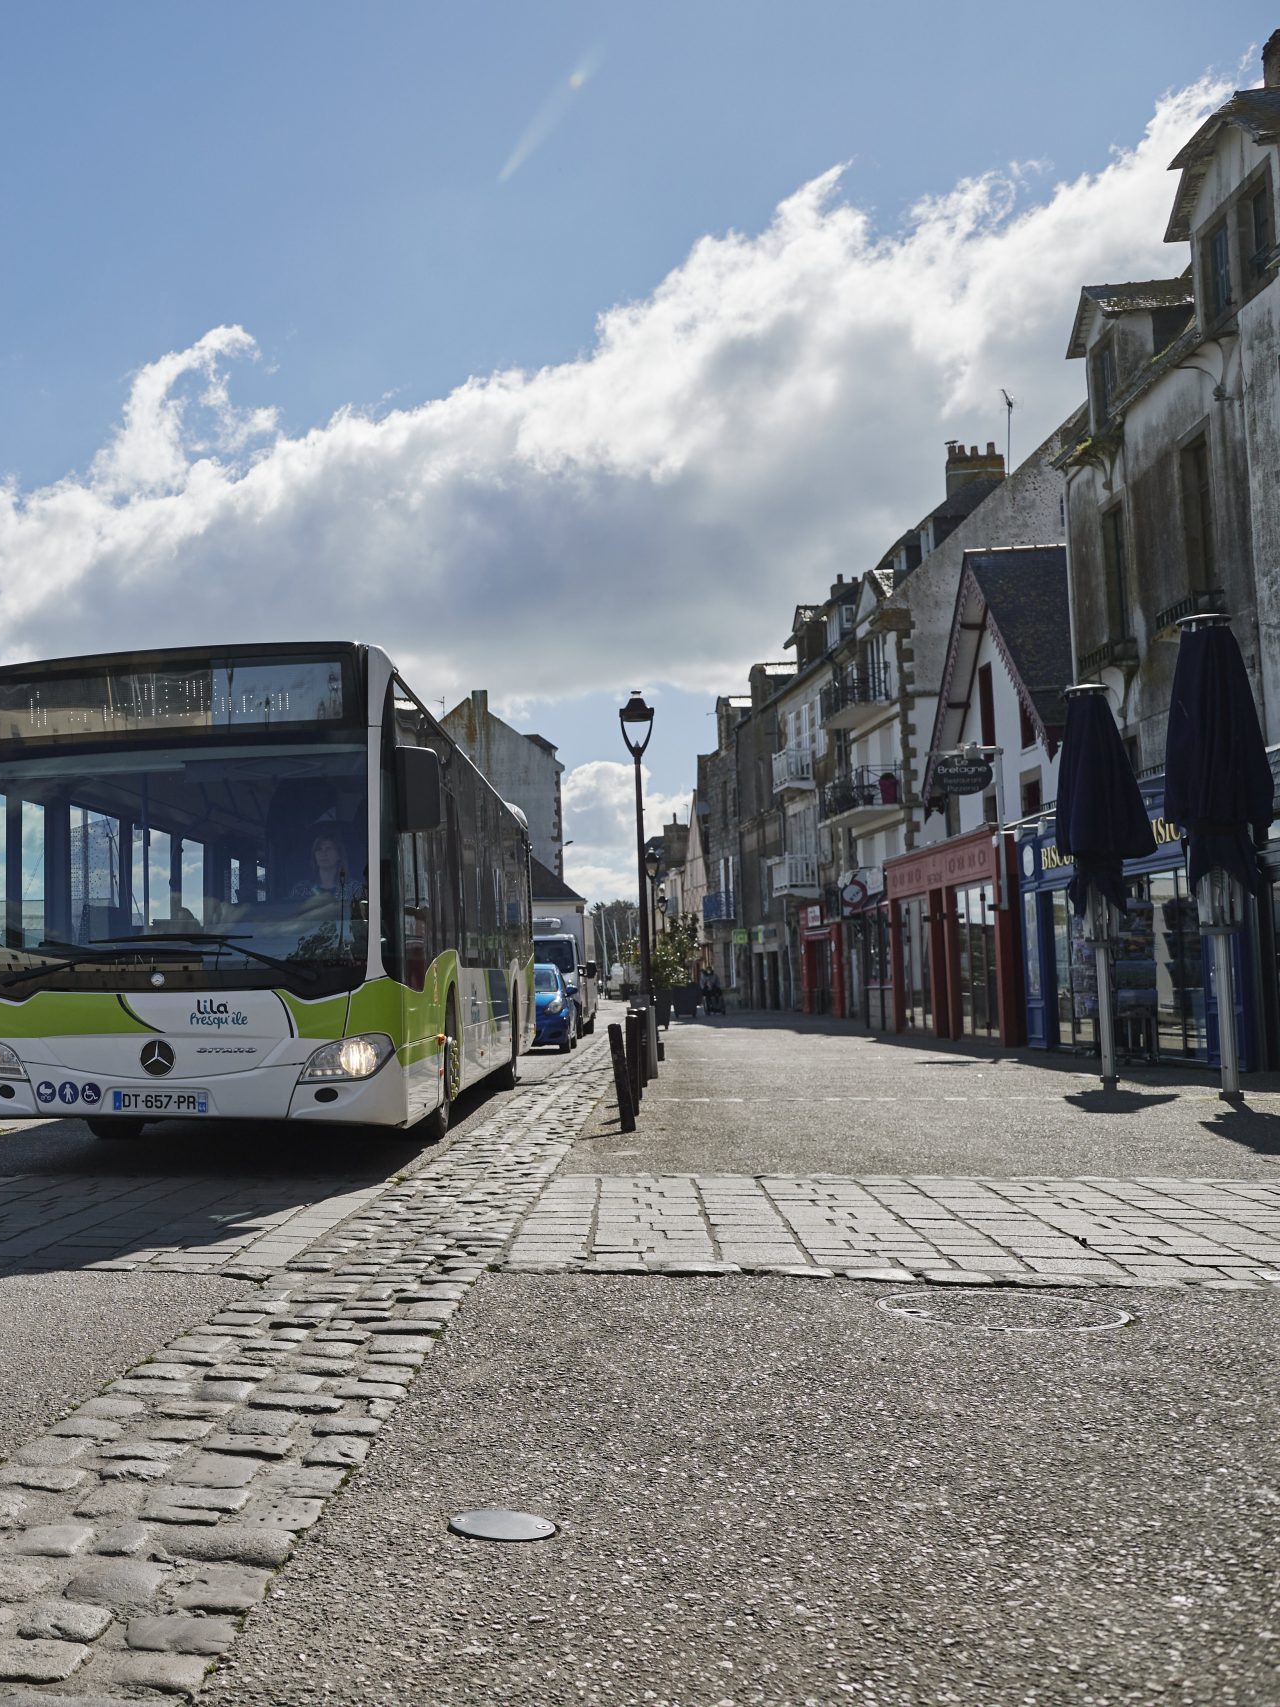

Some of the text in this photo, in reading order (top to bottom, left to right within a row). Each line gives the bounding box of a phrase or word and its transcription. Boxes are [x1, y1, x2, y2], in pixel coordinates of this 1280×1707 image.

[954, 758, 968, 766] Le
[937, 766, 987, 775] Bretagne
[122, 1093, 196, 1110] DT-657-PR
